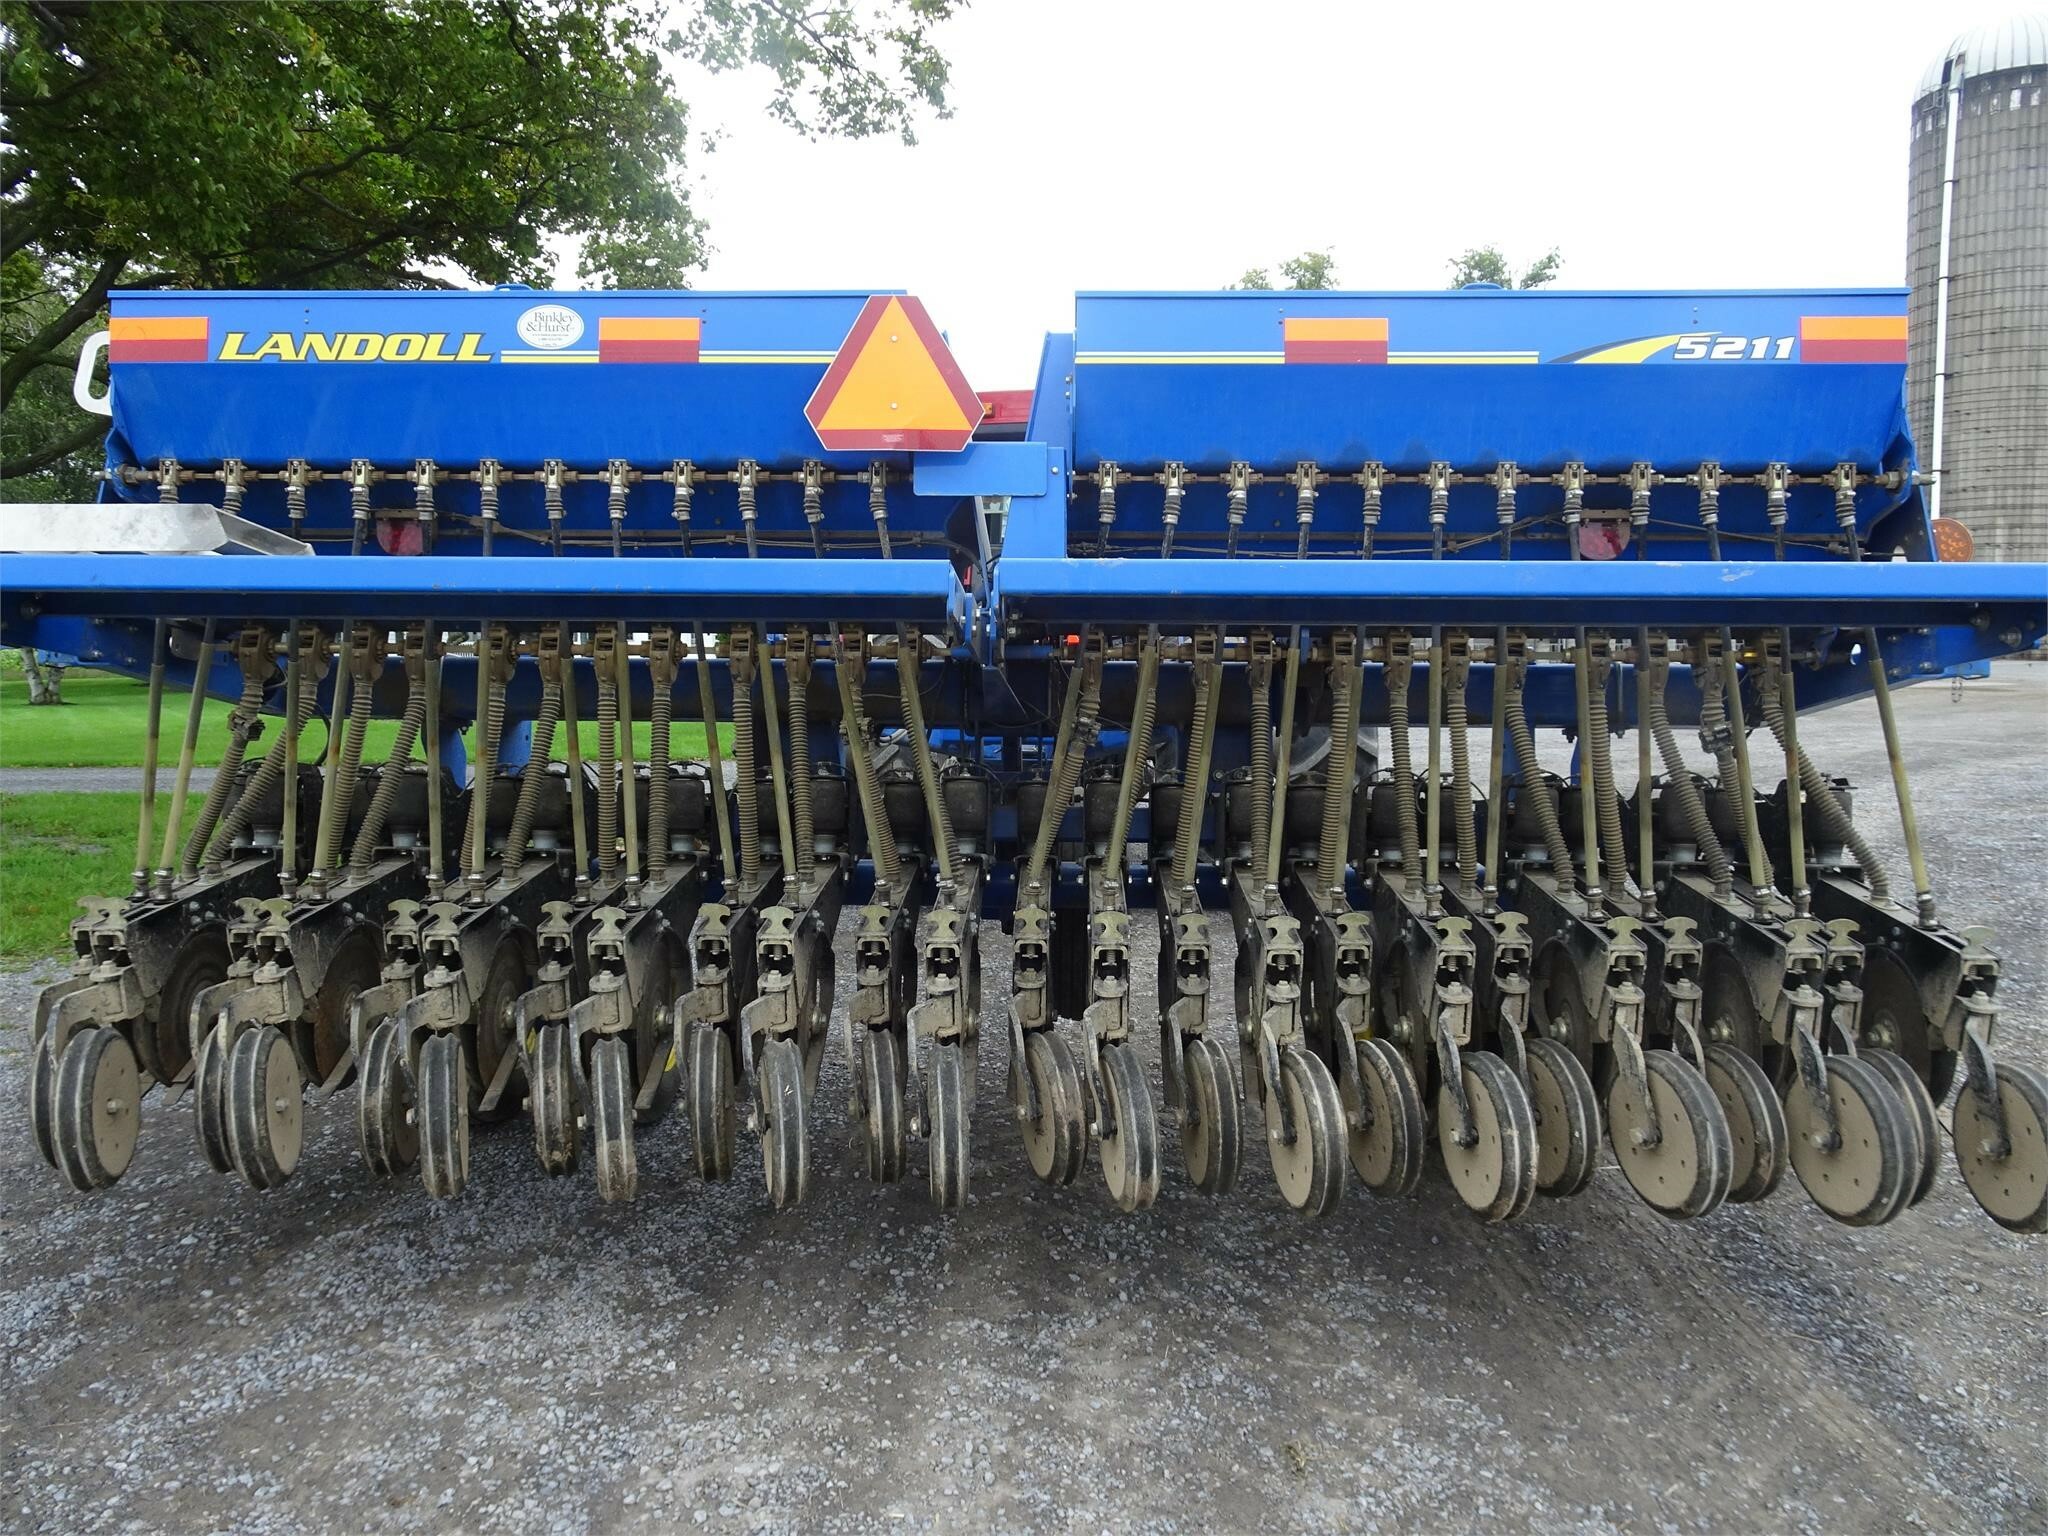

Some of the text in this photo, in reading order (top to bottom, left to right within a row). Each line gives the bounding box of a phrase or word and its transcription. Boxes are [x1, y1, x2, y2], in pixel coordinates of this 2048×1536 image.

[534, 312, 574, 324] Binkley
[217, 332, 493, 362] LANDOLL
[1673, 336, 1796, 361] 5211
